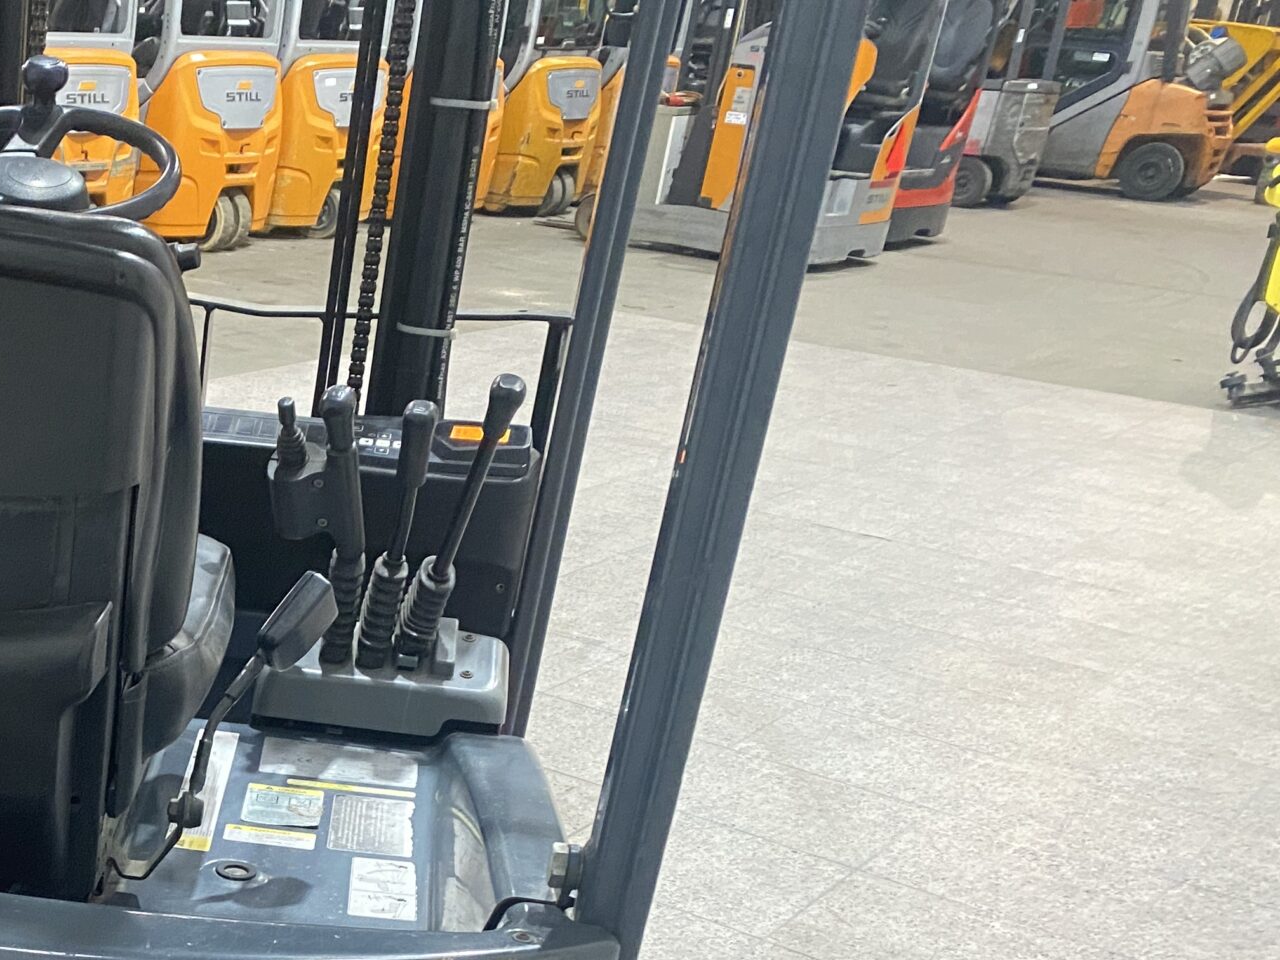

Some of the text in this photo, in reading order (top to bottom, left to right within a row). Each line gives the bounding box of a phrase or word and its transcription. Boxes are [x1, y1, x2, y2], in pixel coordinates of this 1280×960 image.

[66, 93, 110, 104] STILL
[226, 92, 262, 102] STILL
[567, 90, 589, 98] STILL
